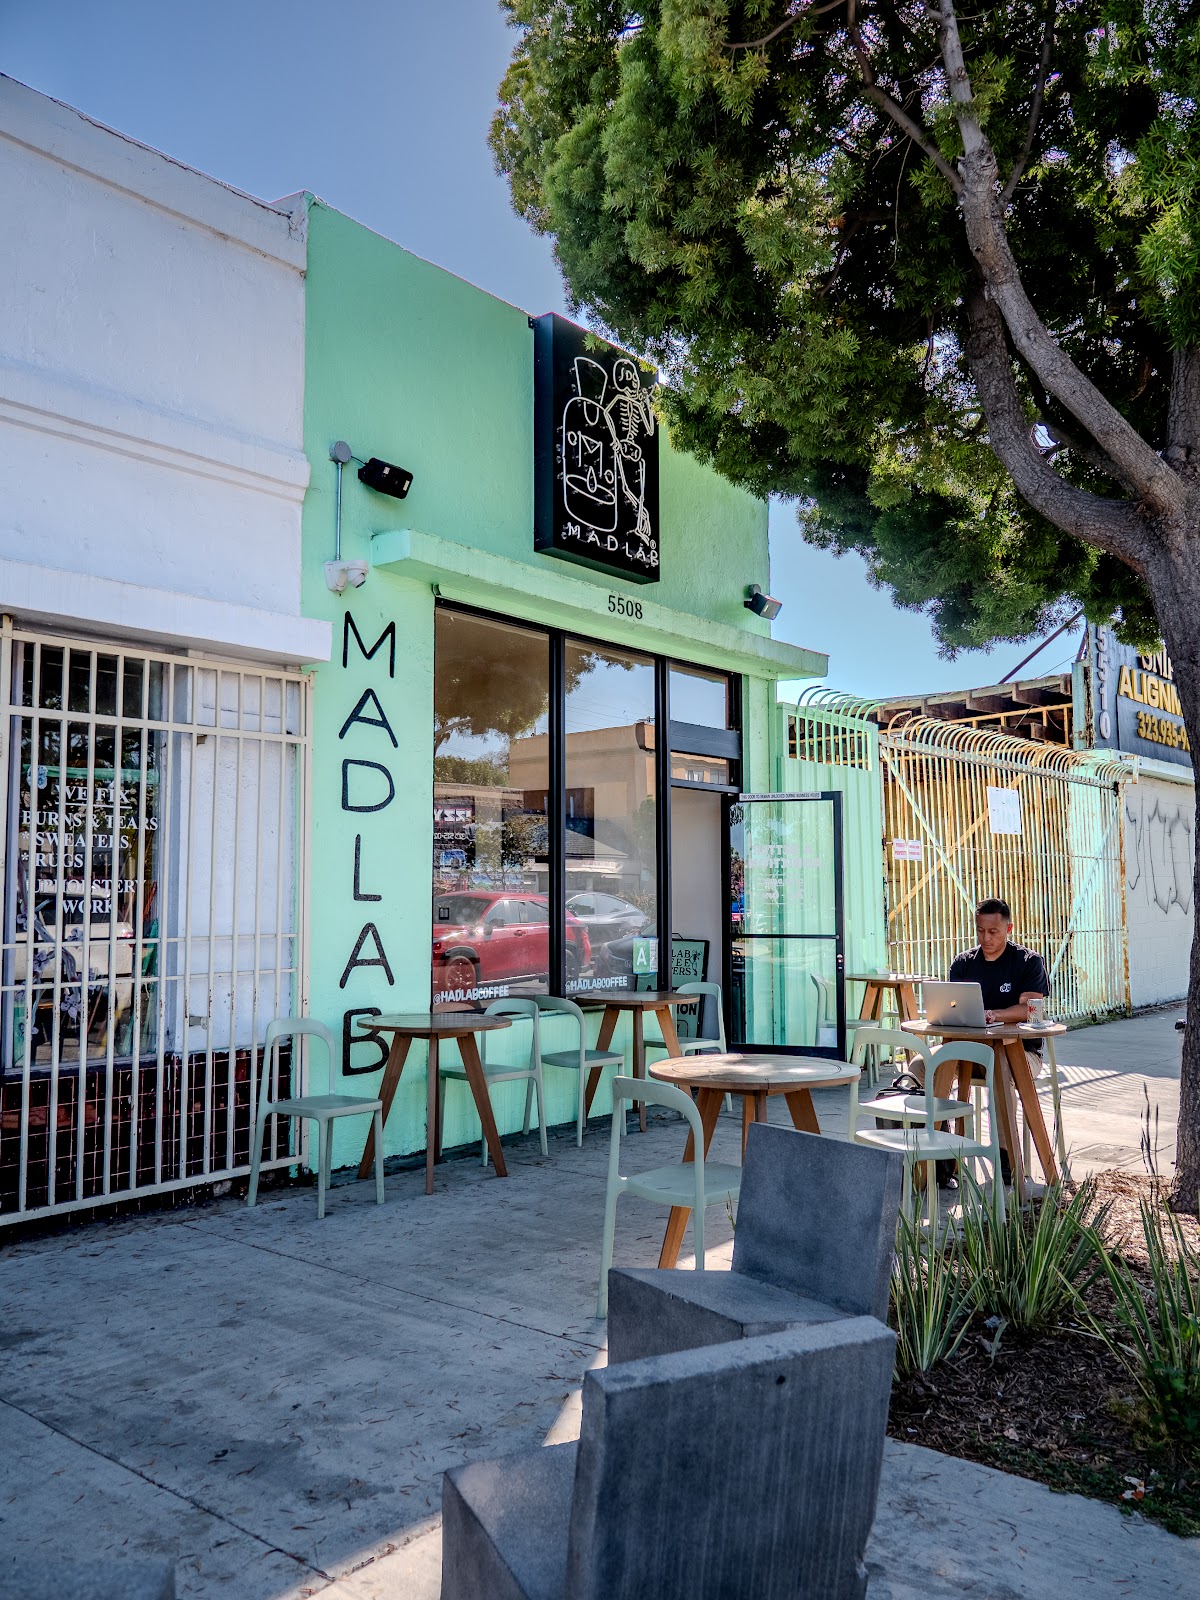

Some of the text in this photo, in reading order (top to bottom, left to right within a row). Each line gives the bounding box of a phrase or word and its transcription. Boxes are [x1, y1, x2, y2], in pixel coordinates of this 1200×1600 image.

[608, 594, 643, 620] 5508
[96, 787, 130, 804] FIX
[35, 853, 84, 868] RUGS
[636, 946, 648, 966] A
[671, 966, 691, 976] ERS
